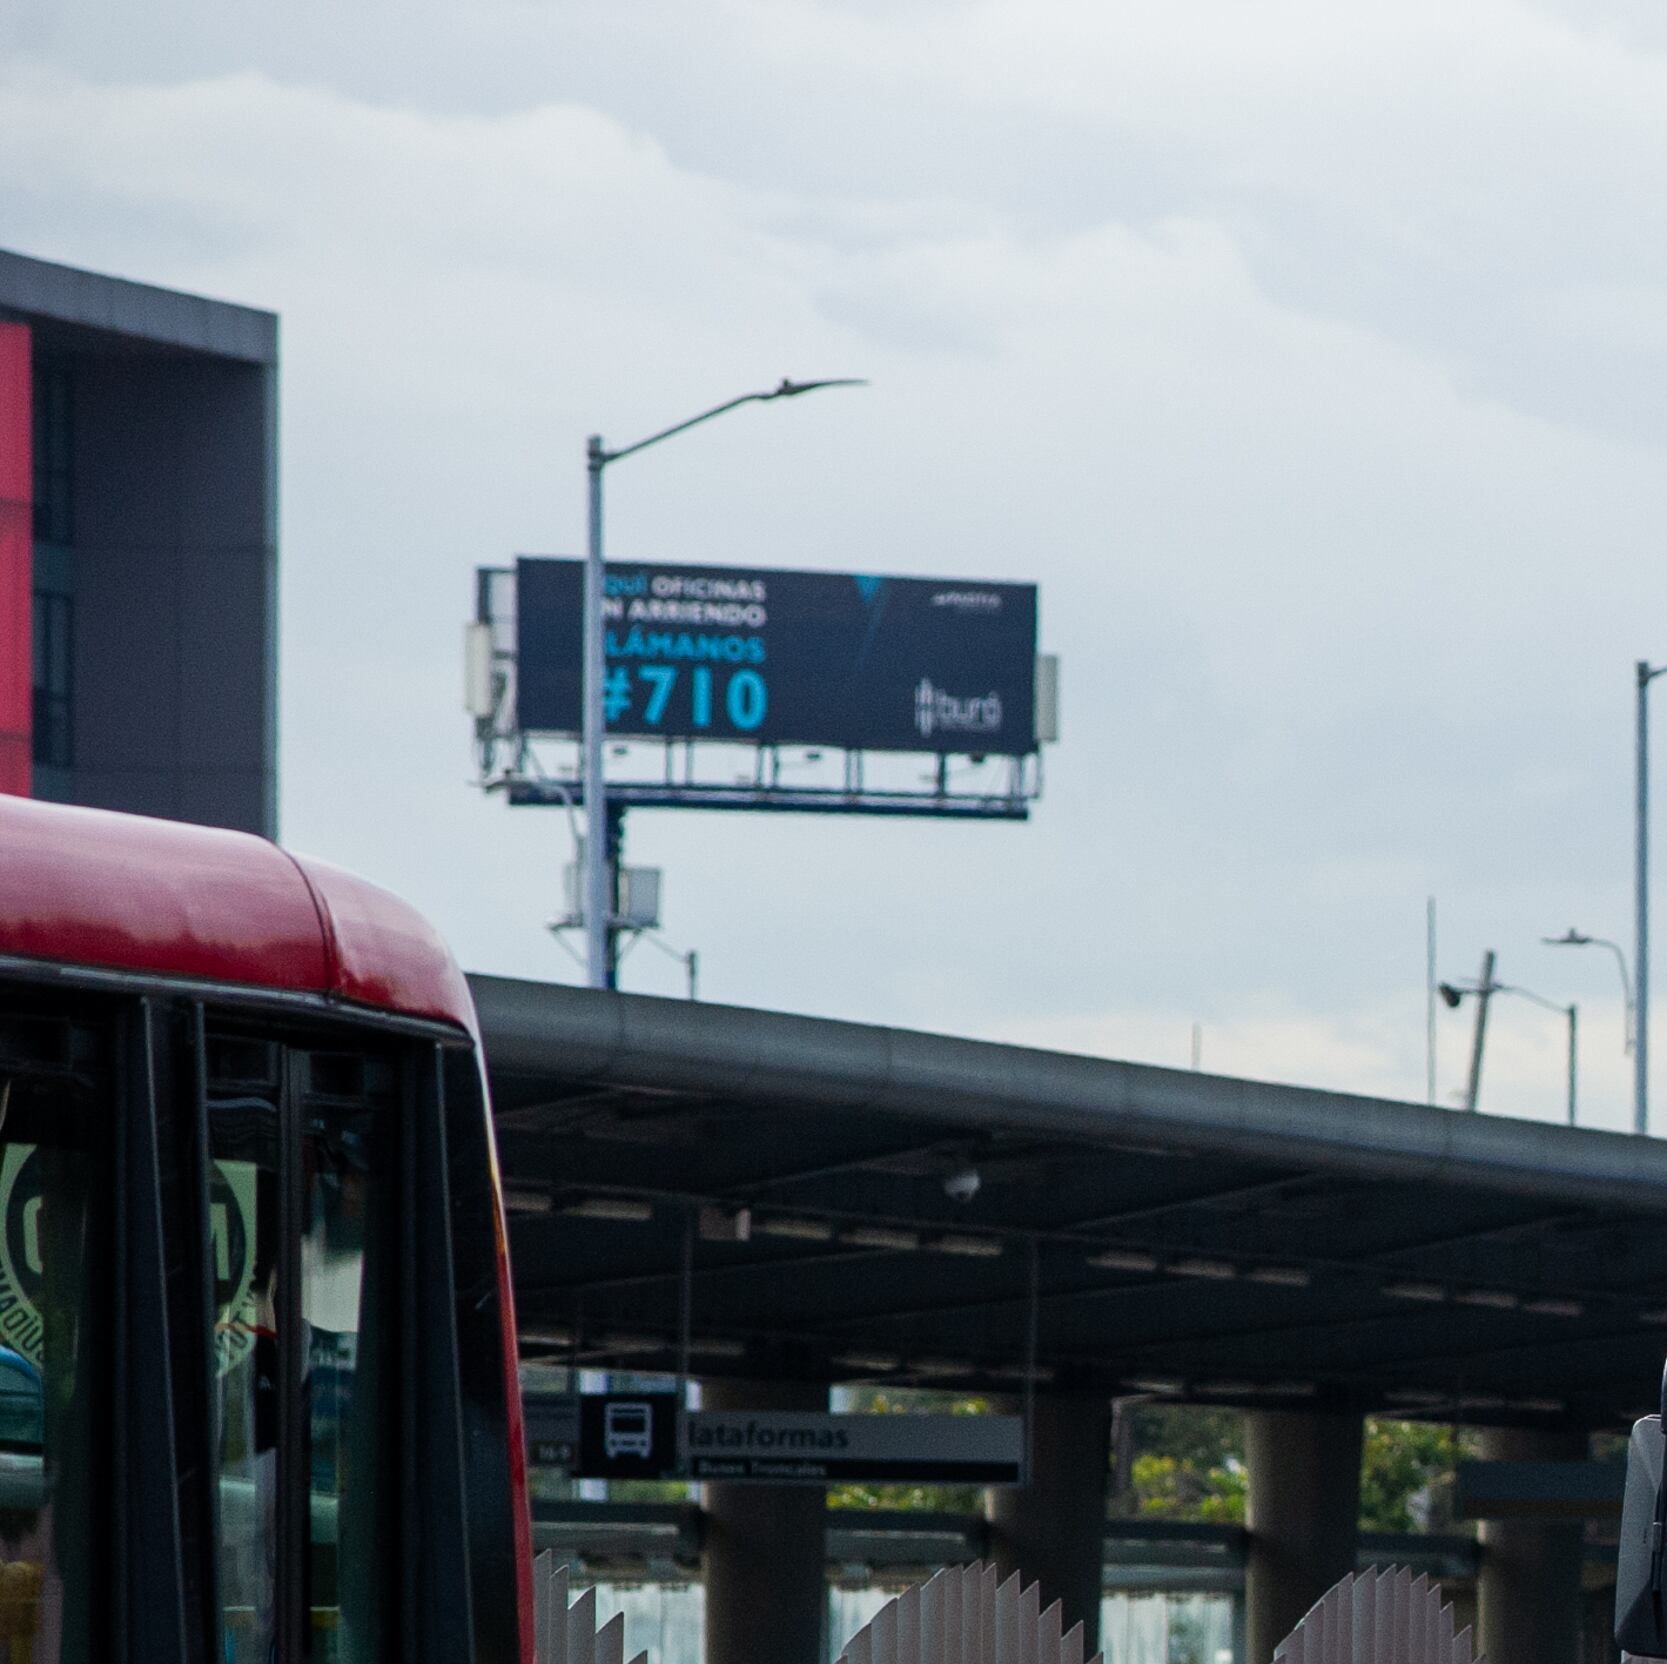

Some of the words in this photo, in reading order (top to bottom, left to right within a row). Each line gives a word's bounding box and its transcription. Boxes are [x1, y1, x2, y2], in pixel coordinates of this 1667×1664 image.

[605, 574, 646, 597] QUÍ
[651, 575, 766, 602] OFICINAS
[601, 597, 624, 621] N
[627, 598, 768, 628] ARRIENDO
[605, 624, 766, 664] LÁMANOS
[604, 664, 768, 730] #710
[686, 1420, 849, 1448] lataformas
